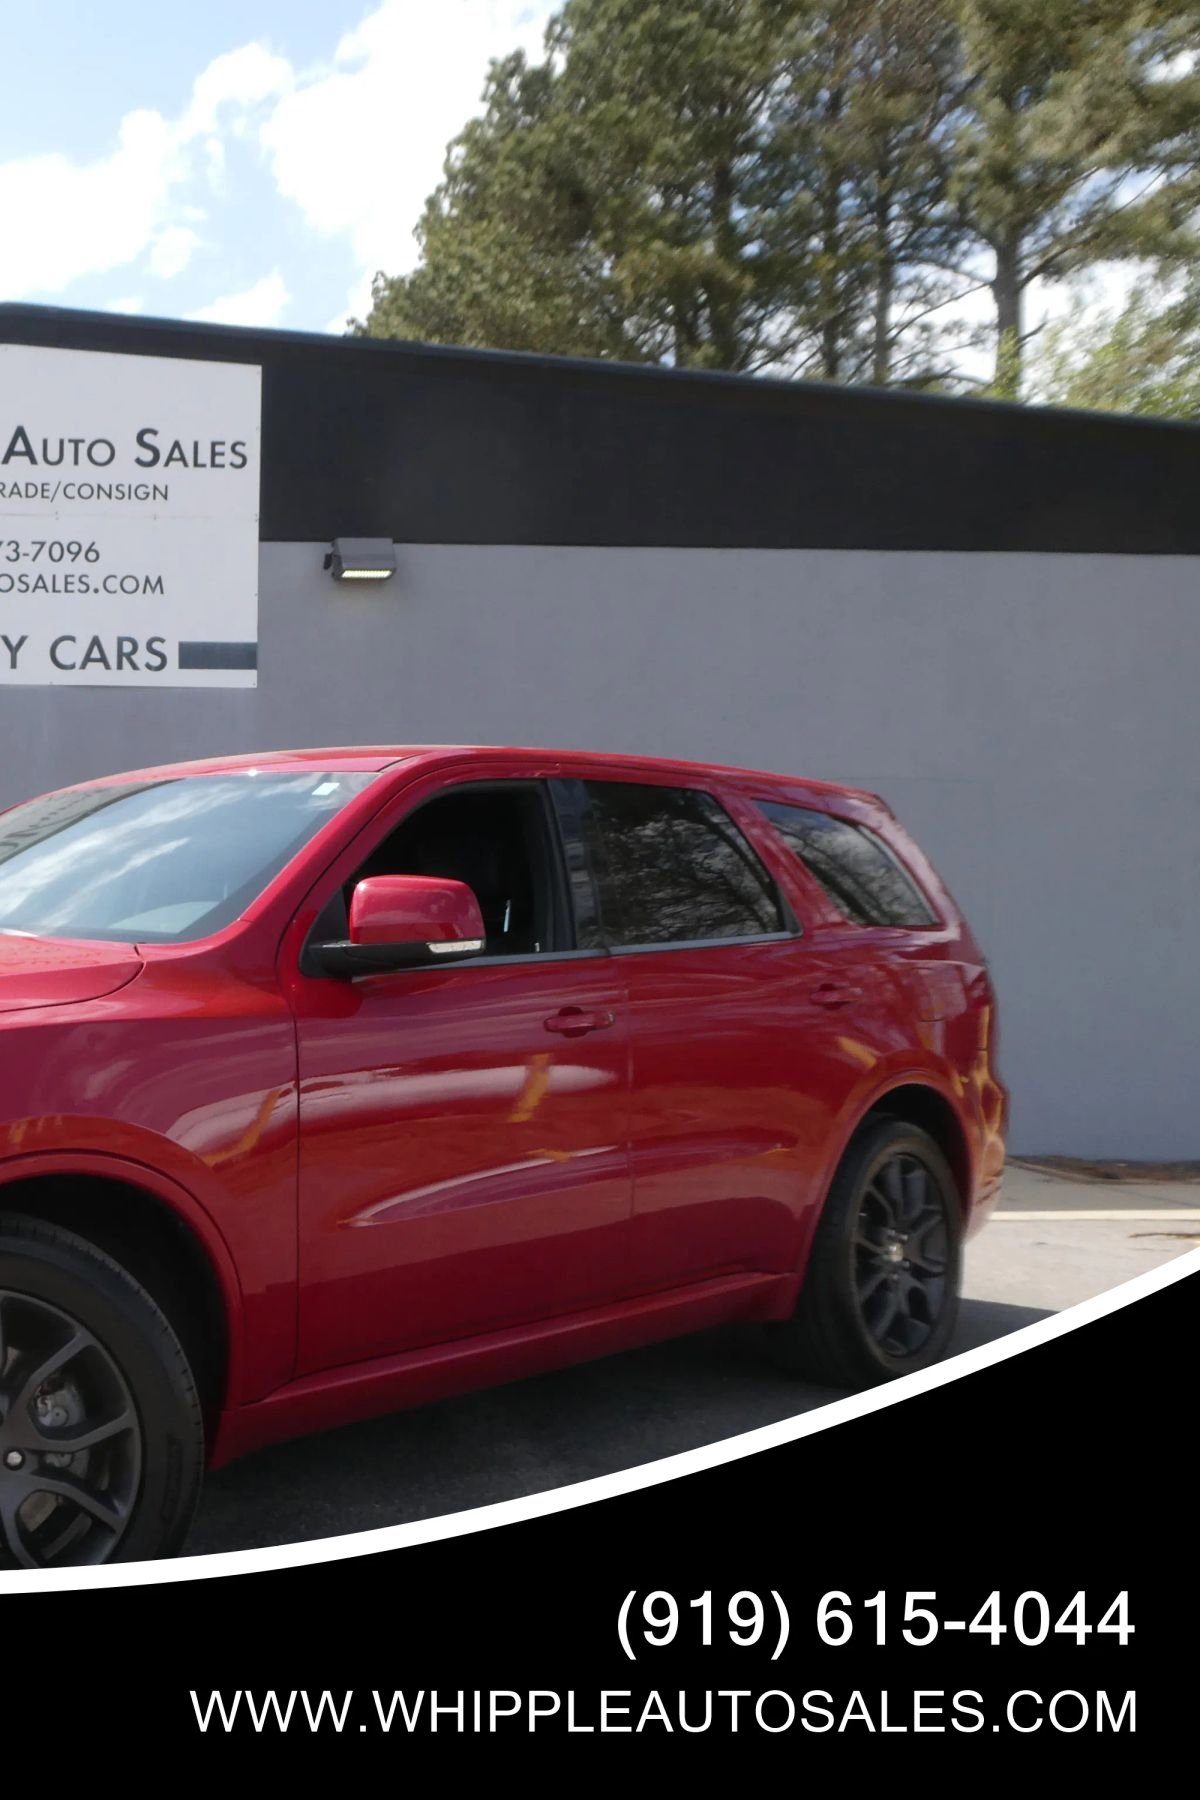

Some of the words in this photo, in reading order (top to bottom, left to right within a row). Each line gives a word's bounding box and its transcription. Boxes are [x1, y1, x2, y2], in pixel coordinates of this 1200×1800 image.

[2, 426, 115, 466] AUTO
[135, 428, 247, 469] SALES
[50, 635, 168, 672] CARS
